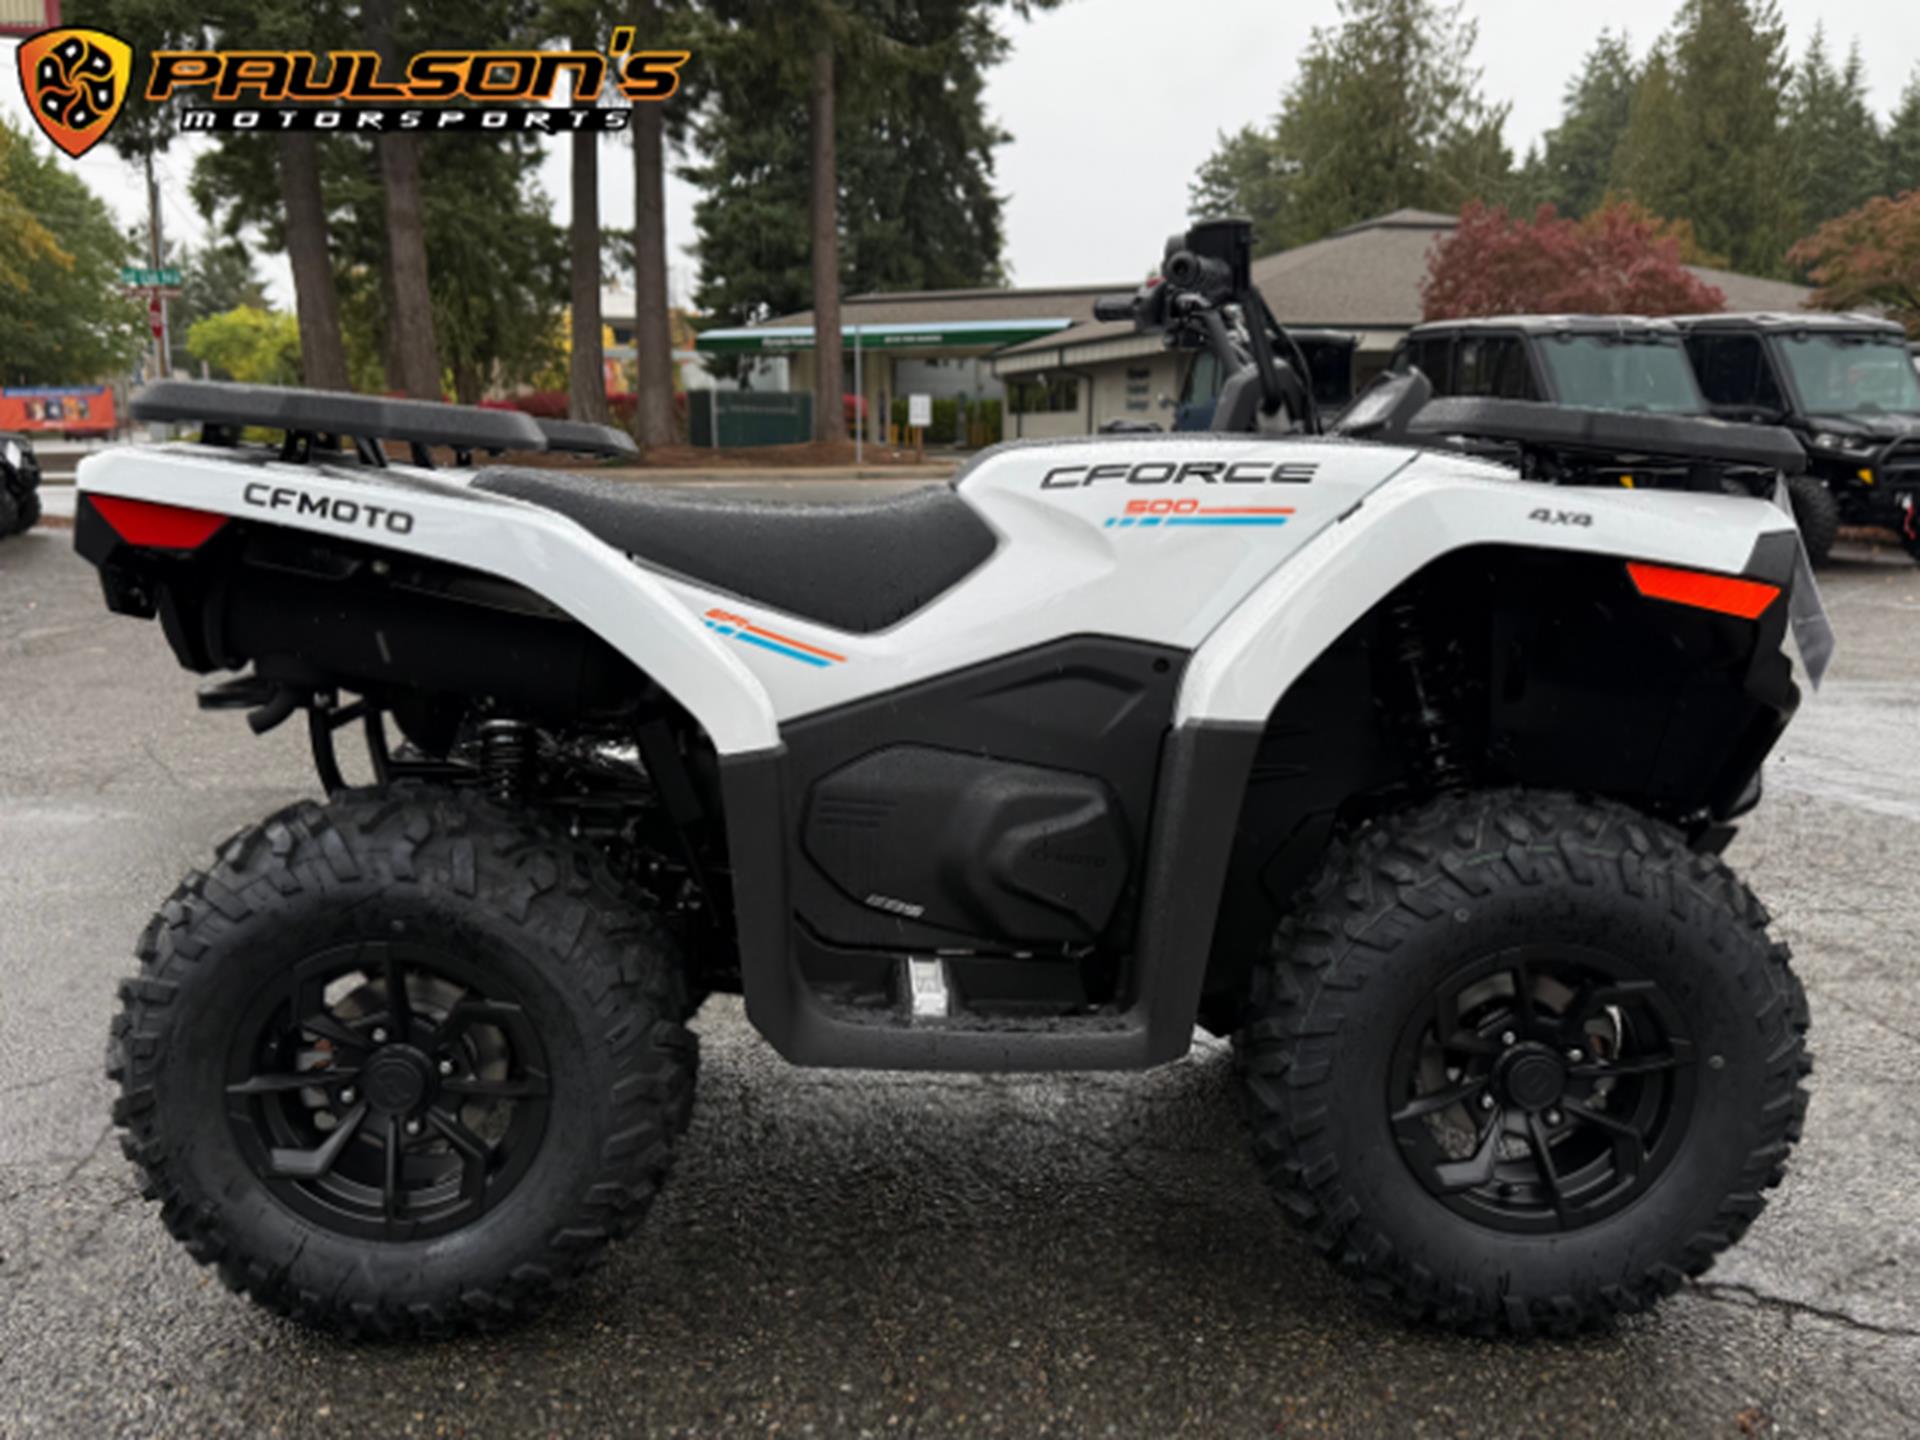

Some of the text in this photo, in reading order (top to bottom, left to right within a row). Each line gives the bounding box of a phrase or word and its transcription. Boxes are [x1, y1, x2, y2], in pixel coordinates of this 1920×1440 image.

[1040, 461, 1319, 490] CFORCE
[243, 482, 415, 535] CFMOTO
[1124, 498, 1199, 514] 500
